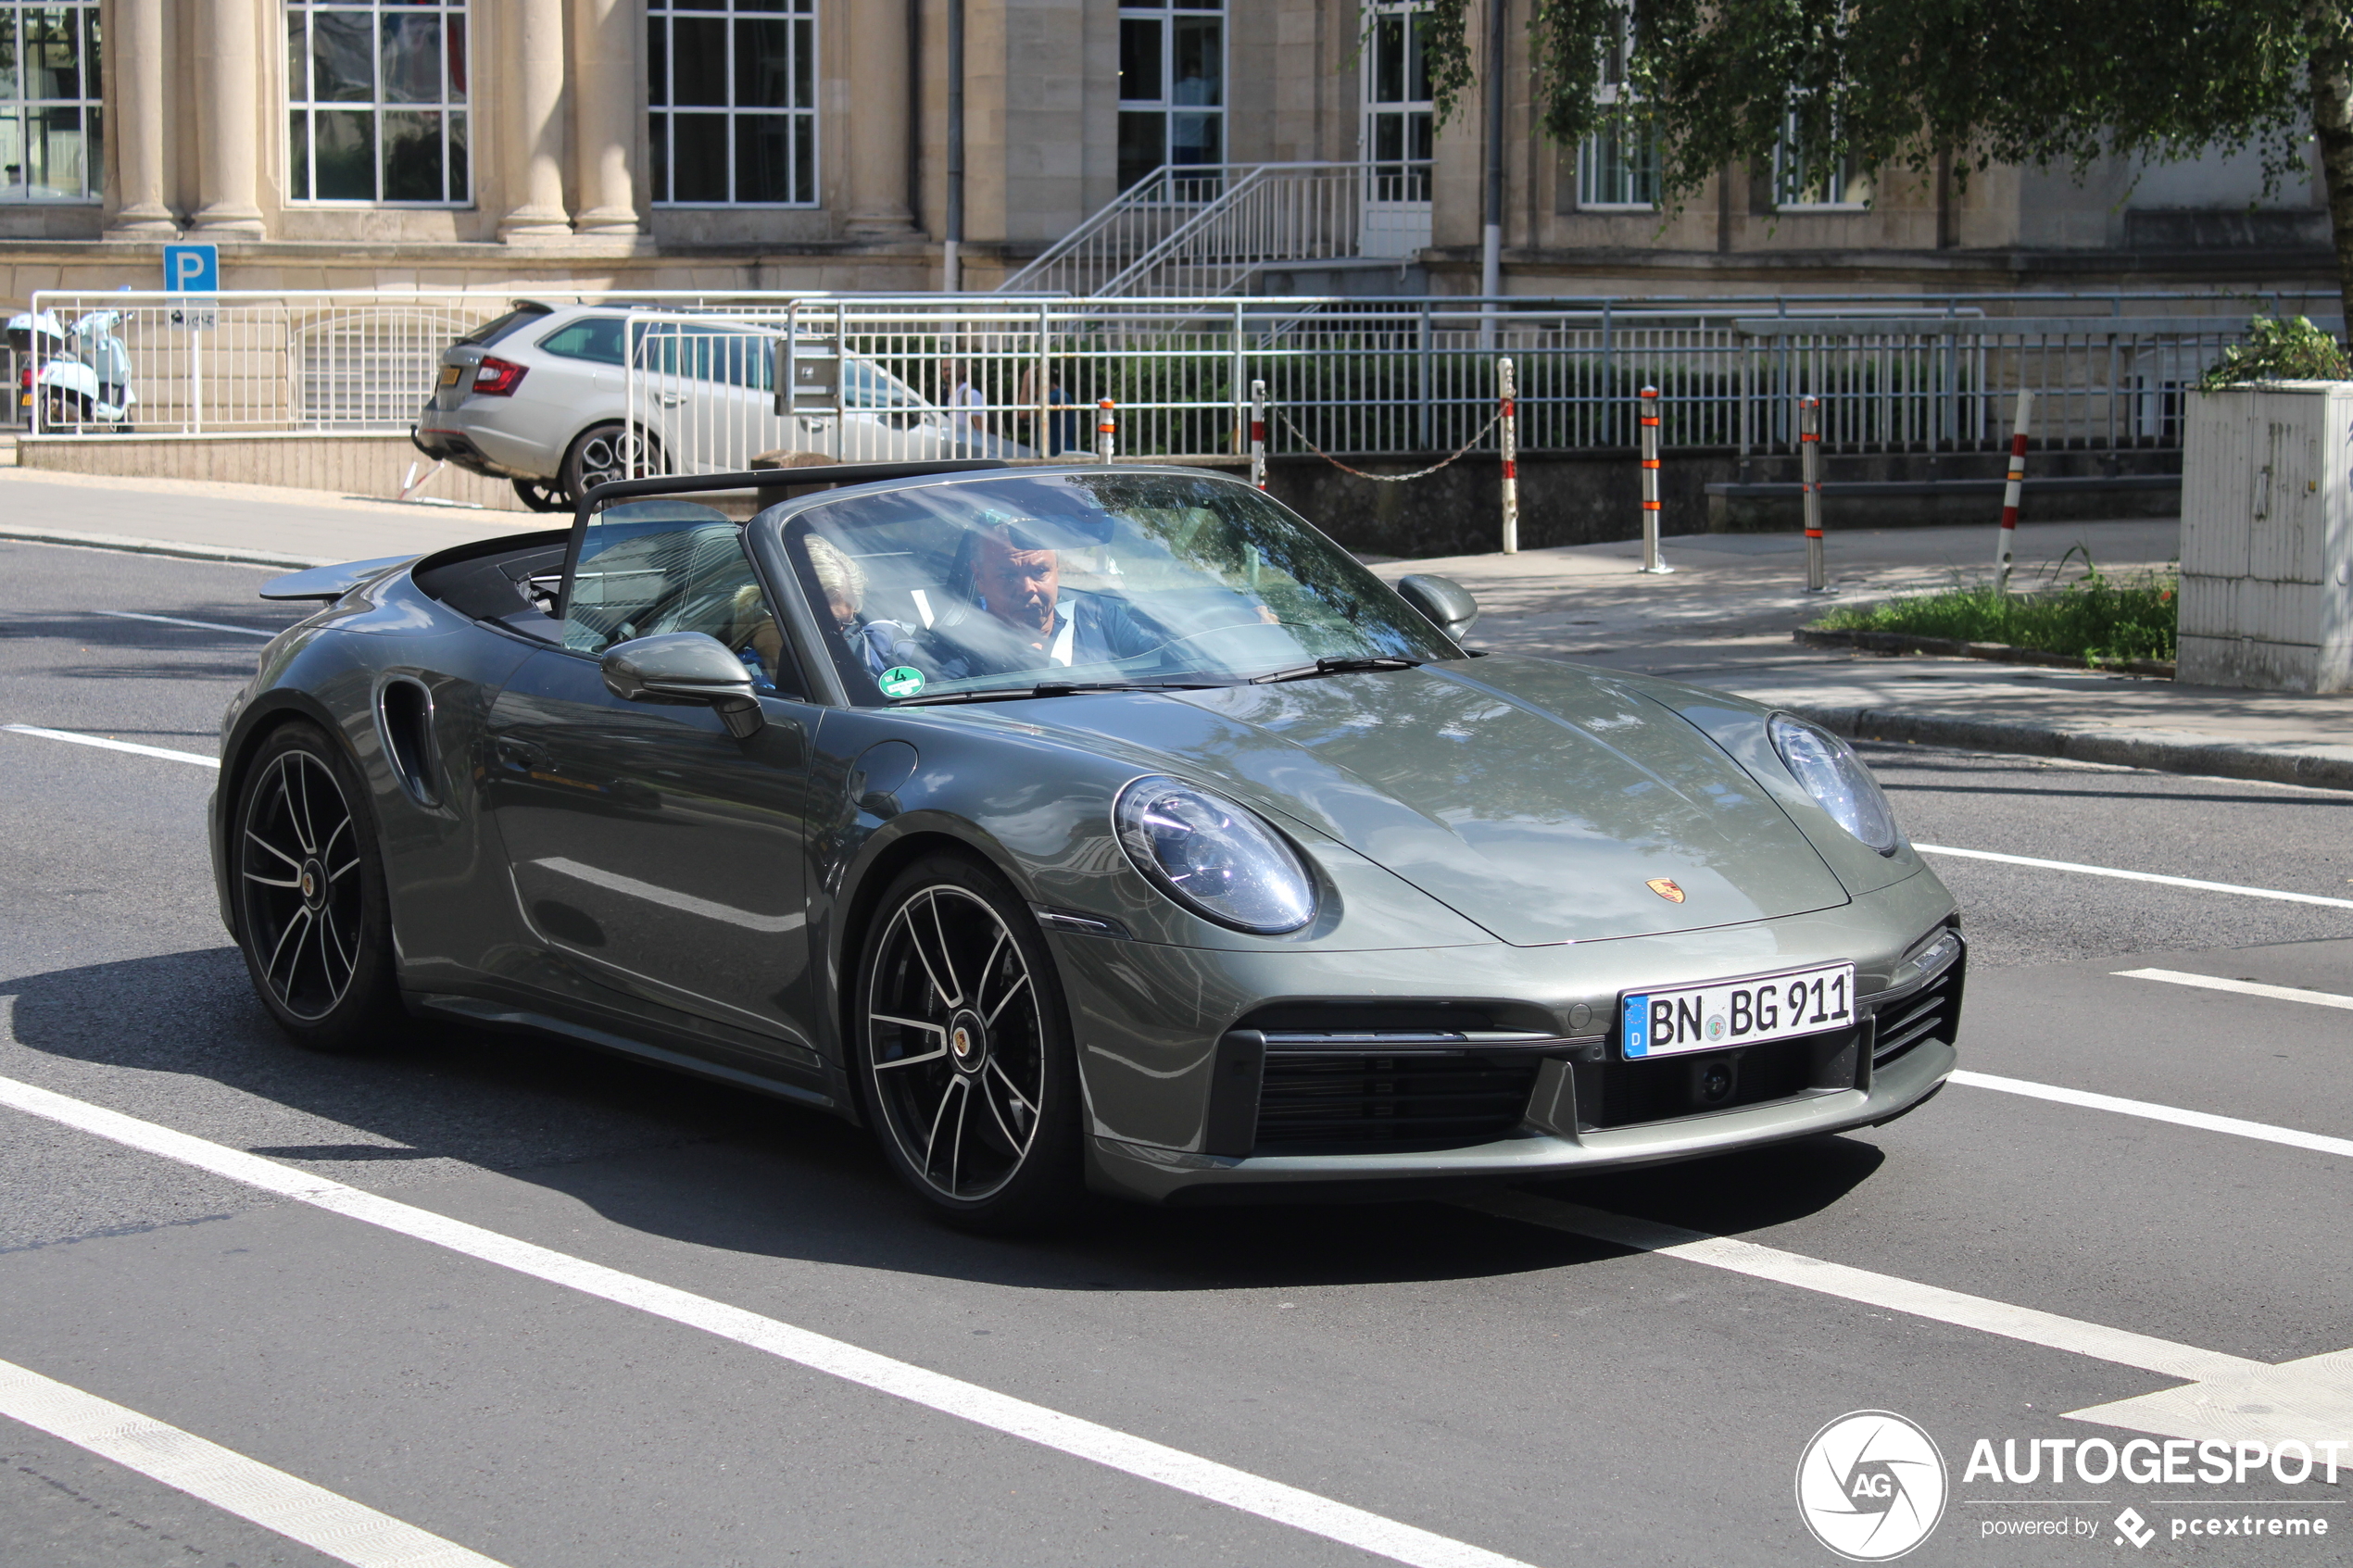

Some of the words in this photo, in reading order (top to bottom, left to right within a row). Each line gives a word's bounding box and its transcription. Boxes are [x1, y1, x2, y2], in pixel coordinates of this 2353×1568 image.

[177, 252, 204, 291] P
[895, 669, 907, 681] 4
[925, 982, 935, 1044] POSCHE
[1631, 1033, 1641, 1046] D
[1650, 995, 1702, 1047] BN
[1730, 985, 1778, 1035] BG
[1788, 974, 1849, 1026] 911
